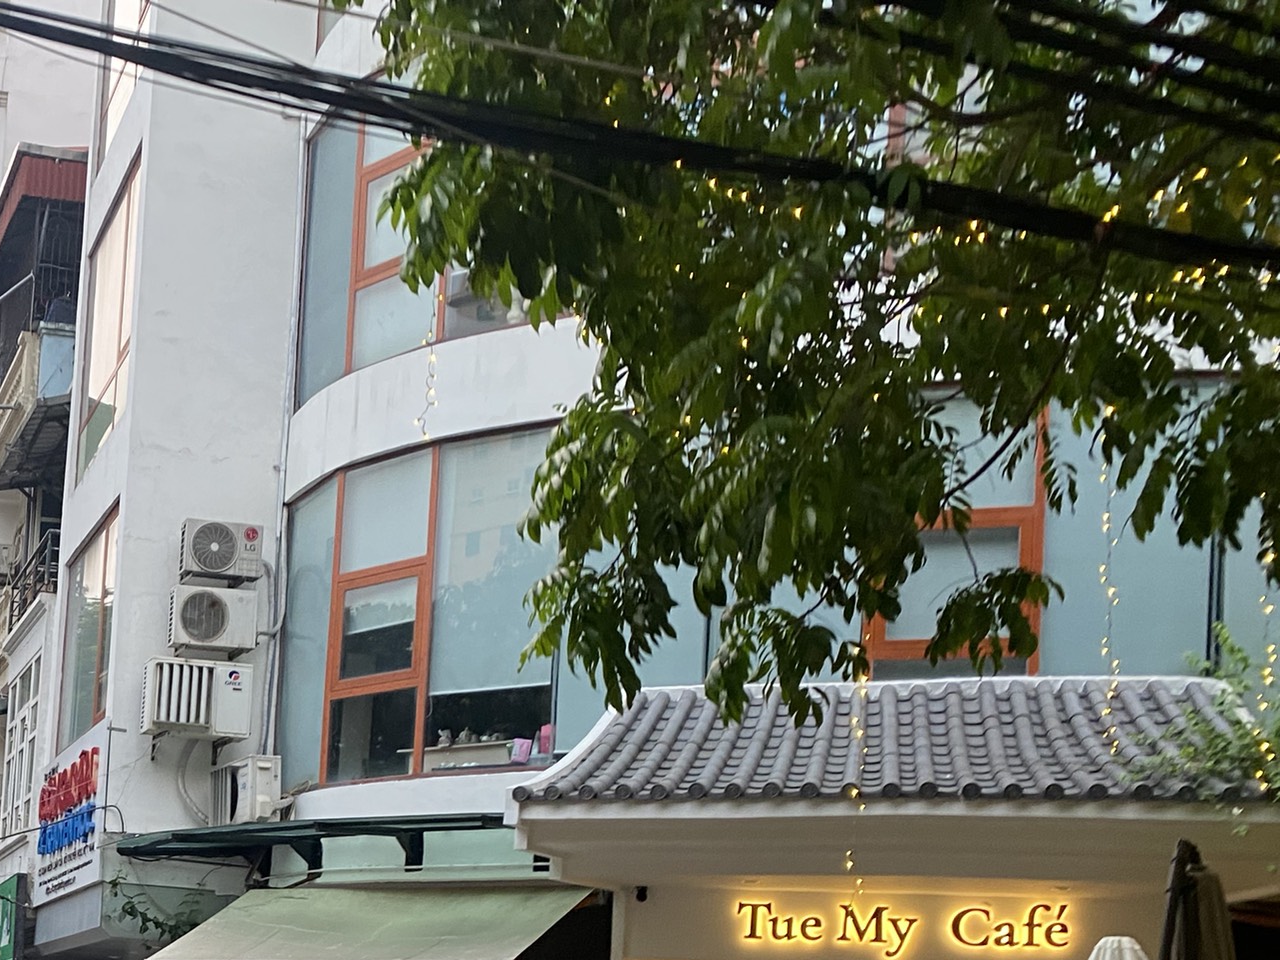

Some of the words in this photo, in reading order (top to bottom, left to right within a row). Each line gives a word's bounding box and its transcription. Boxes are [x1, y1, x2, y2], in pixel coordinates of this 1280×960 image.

[244, 543, 256, 552] LG
[737, 902, 823, 941] Tue
[837, 904, 918, 957] My
[951, 904, 1069, 948] Café
